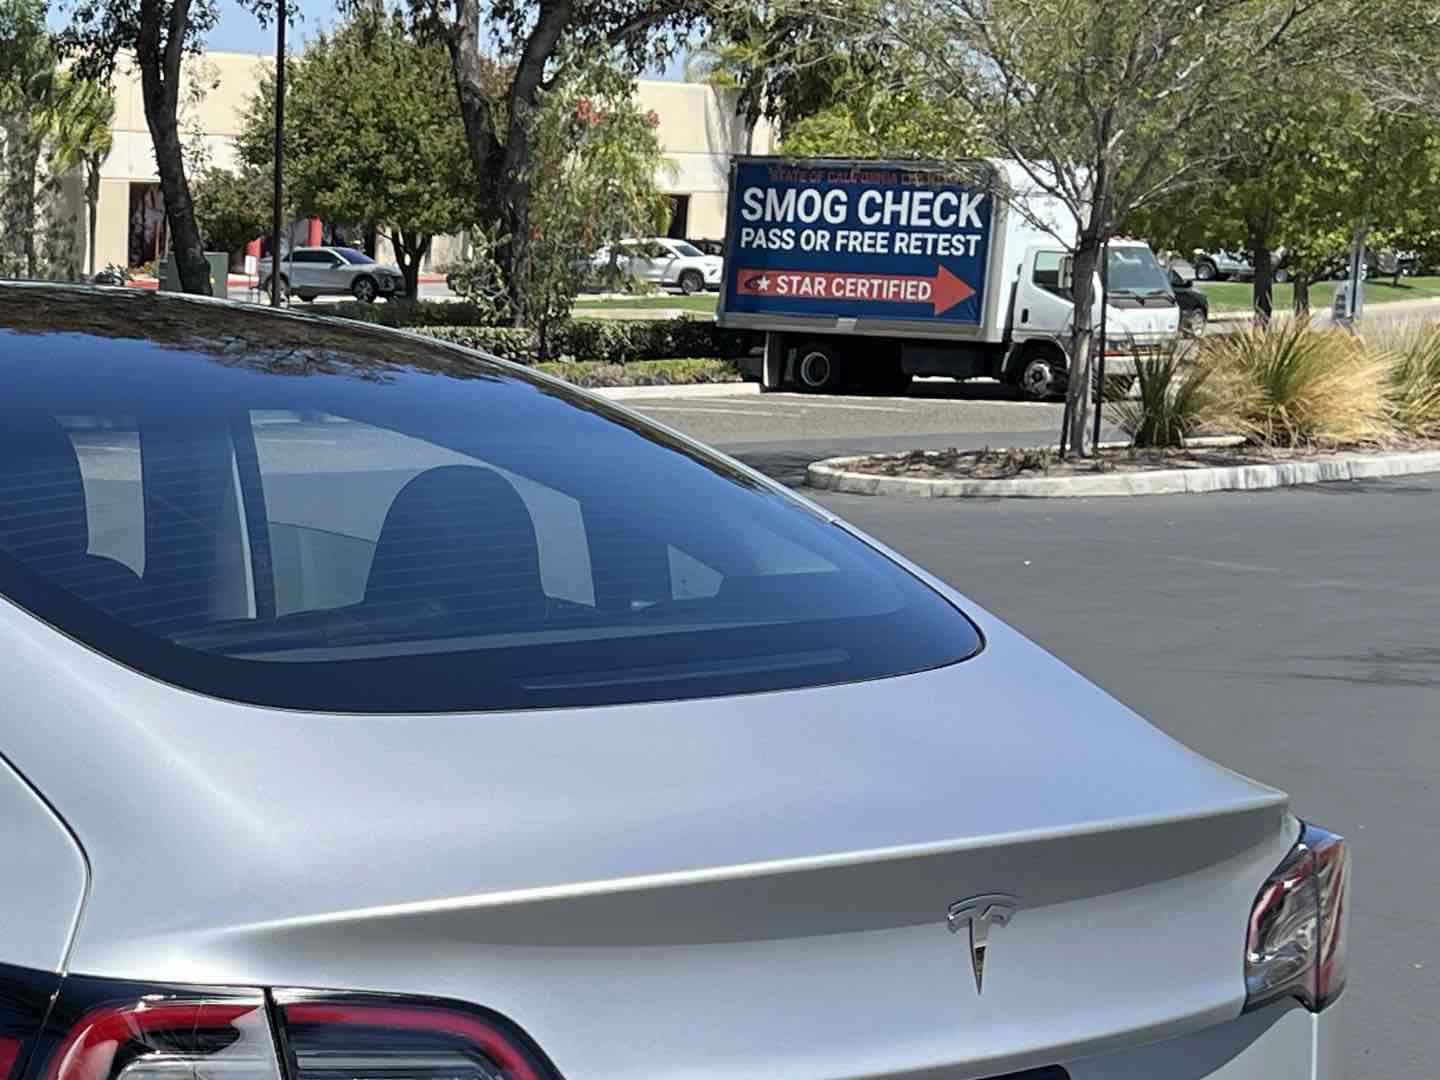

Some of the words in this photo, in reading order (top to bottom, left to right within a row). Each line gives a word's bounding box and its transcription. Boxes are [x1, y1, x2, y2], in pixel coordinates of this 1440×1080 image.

[741, 187, 848, 224] SMOG
[858, 190, 984, 228] CHECK
[740, 228, 795, 249] PASS
[800, 230, 830, 251] OR
[835, 231, 888, 253] FREE
[894, 233, 981, 257] RETEST
[776, 275, 826, 297] STAR
[831, 277, 932, 301] CERTIFIED
